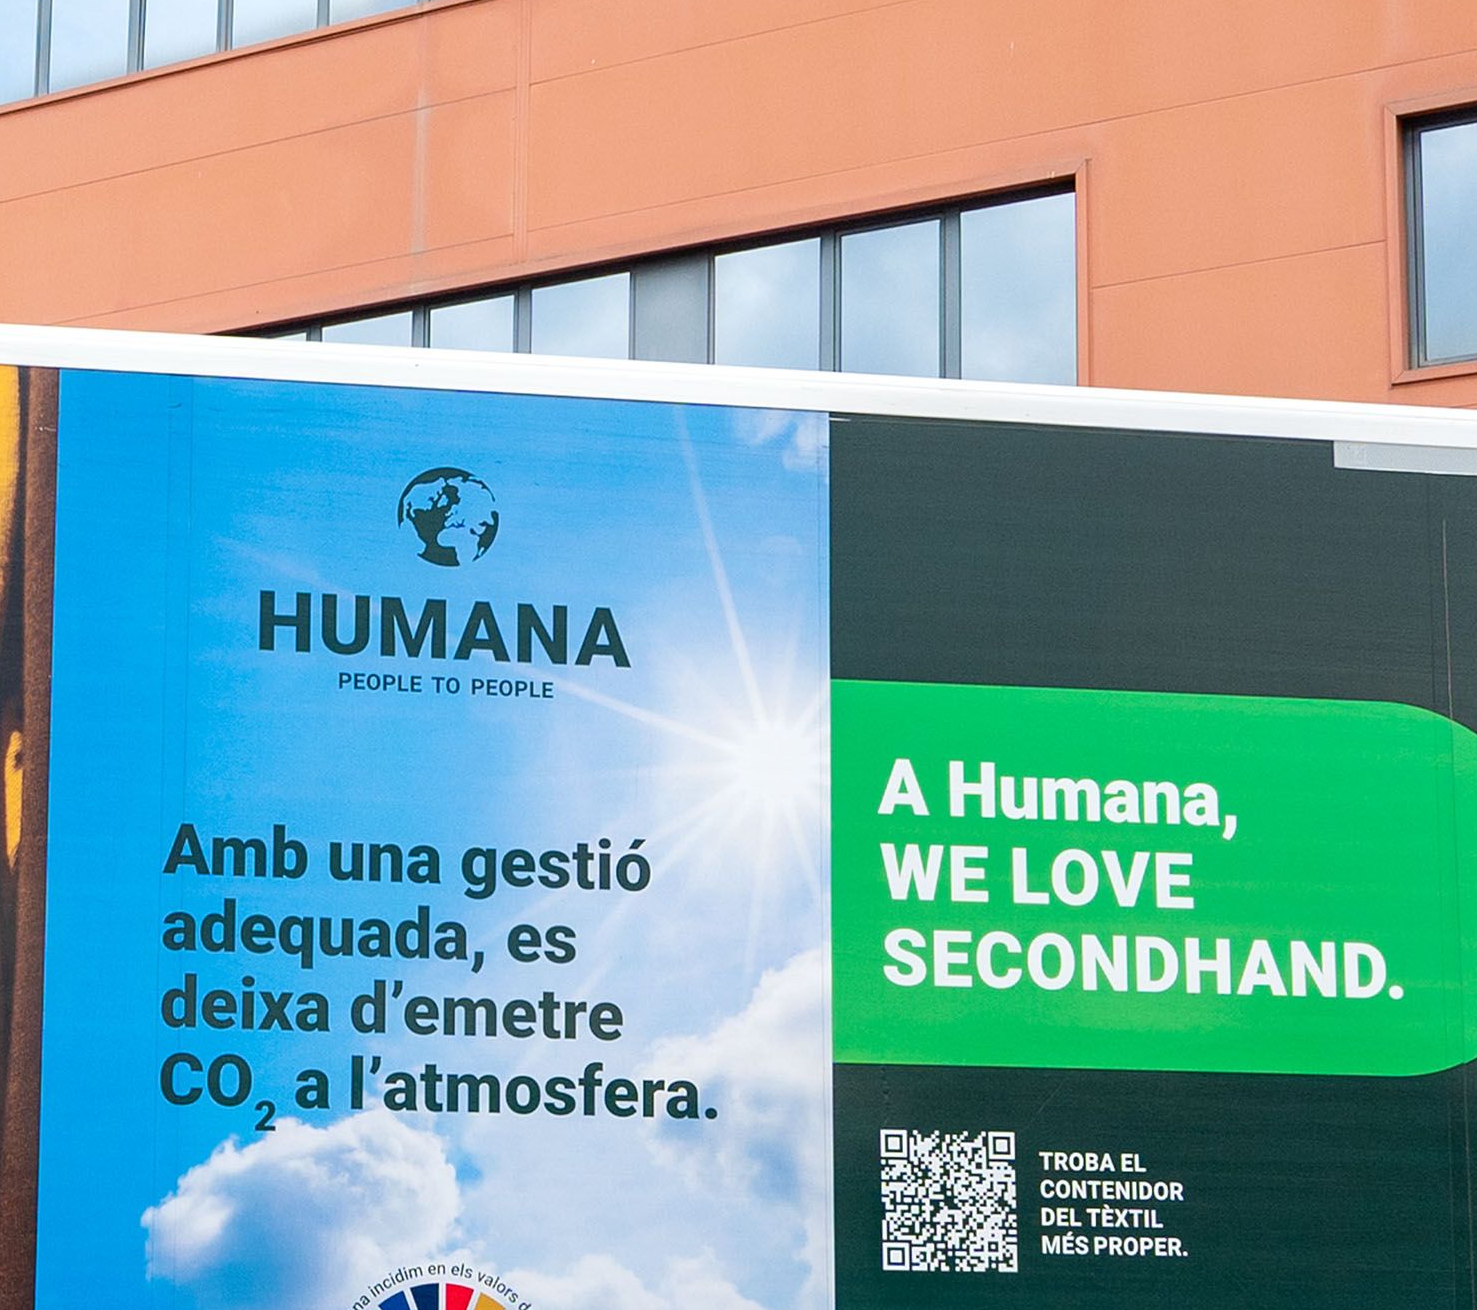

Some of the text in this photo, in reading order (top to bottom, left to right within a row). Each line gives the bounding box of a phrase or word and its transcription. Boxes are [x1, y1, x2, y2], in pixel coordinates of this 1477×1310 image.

[257, 590, 631, 668] HUMANA
[338, 672, 554, 699] PEOPLE TO PEOPLE
[877, 757, 1238, 841] A Humana,
[163, 823, 651, 899] Amb una gestió
[880, 842, 1195, 910] WE LOVE
[162, 898, 577, 973] adequada, es
[882, 927, 1404, 1000] SECONDHAND.
[161, 974, 624, 1041] deixa d’emetre
[294, 1072, 330, 1111] a
[350, 1054, 720, 1120] l’atmosfera.
[1039, 1151, 1147, 1173] TROBA EL
[1039, 1180, 1184, 1201] CONTENIDOR
[1041, 1204, 1164, 1229] DEL TÈXTIL
[1041, 1231, 1189, 1257] MÉS PROPER.
[369, 1264, 423, 1298] incidim
[428, 1264, 446, 1275] en
[451, 1264, 473, 1279] els
[477, 1270, 519, 1304] valors
